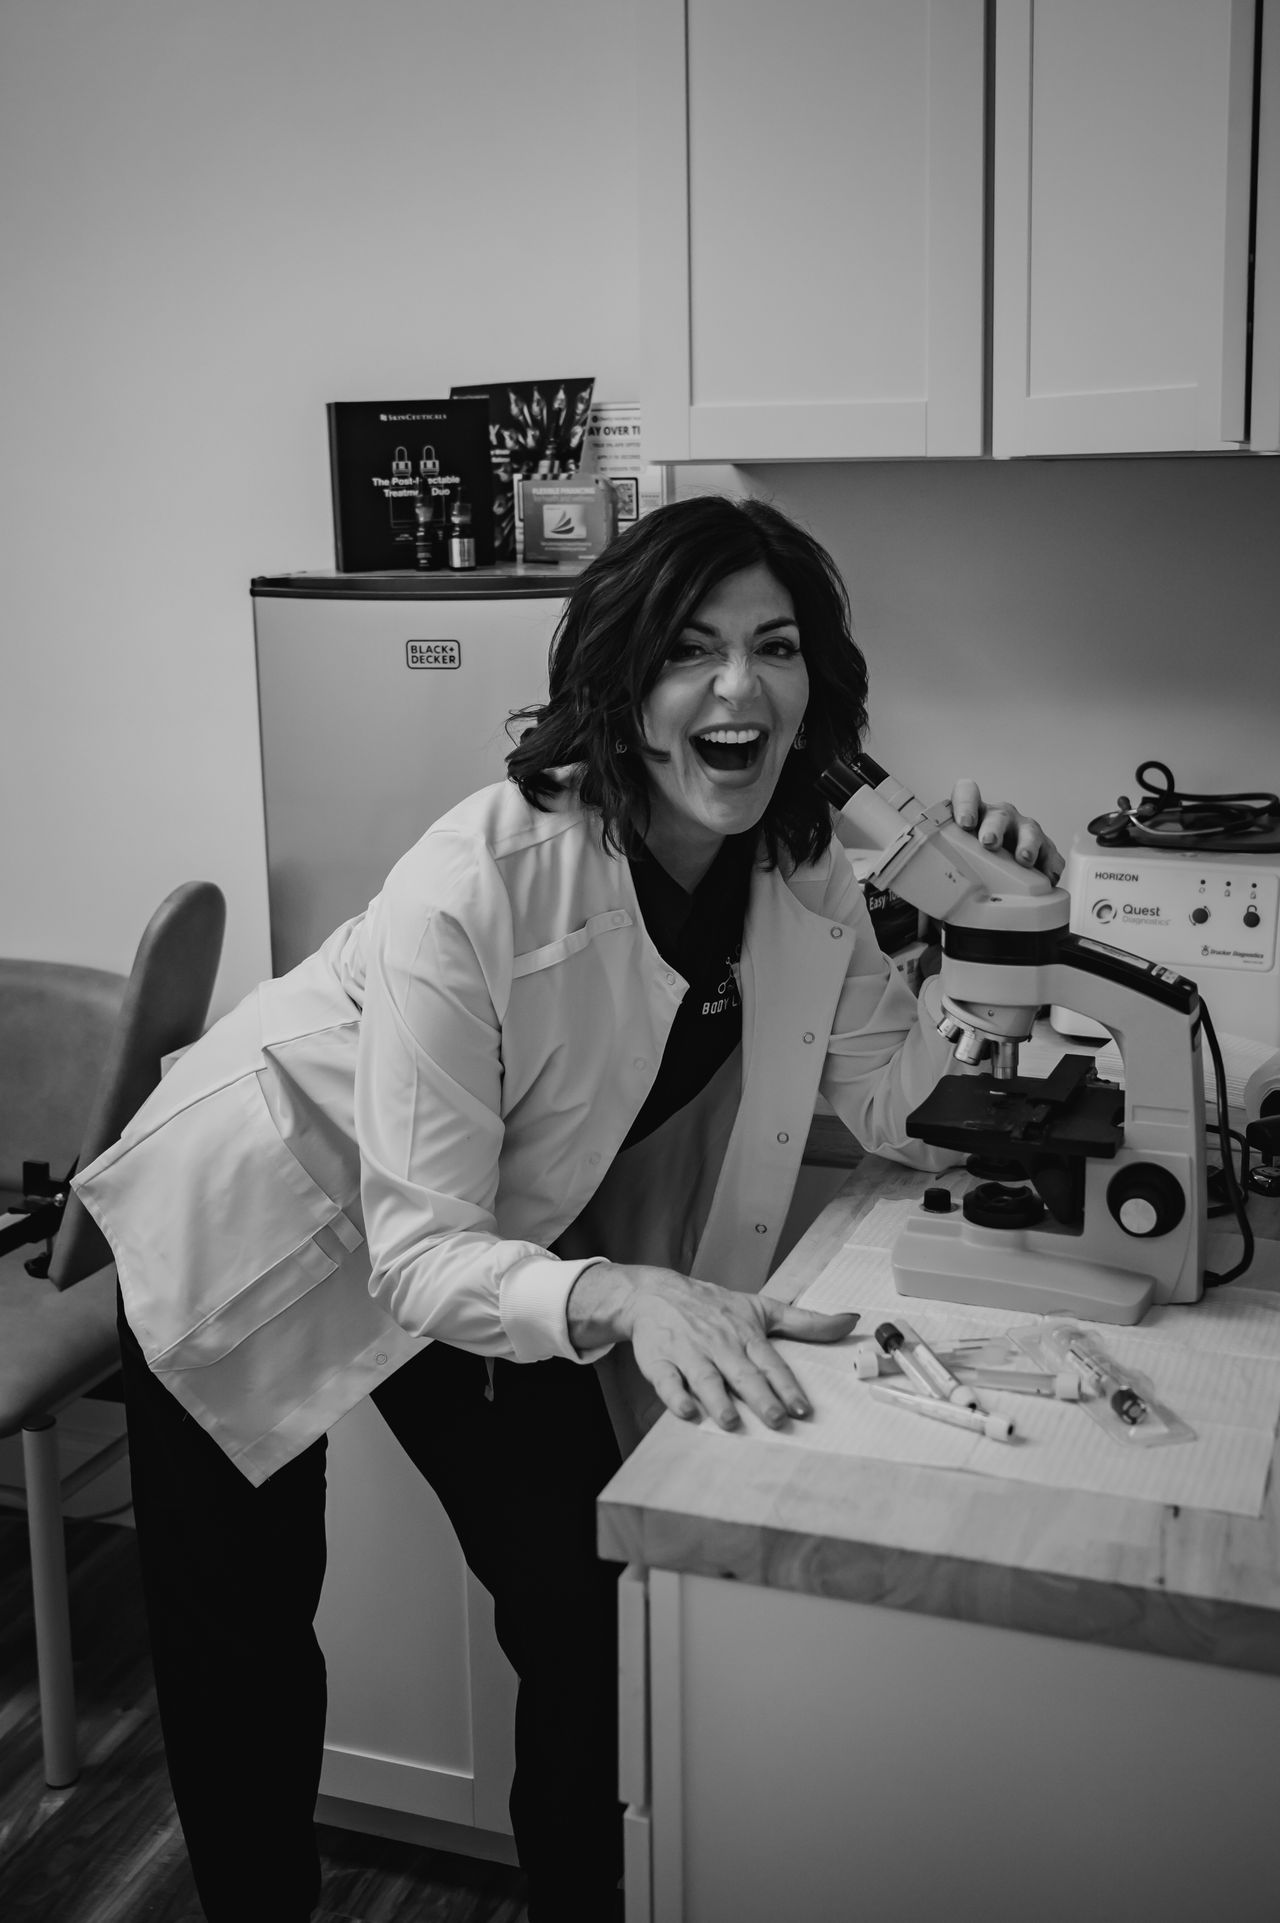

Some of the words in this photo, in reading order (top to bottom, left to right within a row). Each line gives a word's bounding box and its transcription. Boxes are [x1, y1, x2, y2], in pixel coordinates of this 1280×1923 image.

[588, 426, 601, 437] AY
[603, 426, 629, 436] OVER
[631, 425, 640, 435] TI
[372, 477, 390, 487] The
[431, 487, 450, 496] Duo
[410, 645, 455, 654] BLACK+
[411, 655, 456, 664] DECKER
[1095, 872, 1139, 882] HORIZON
[870, 895, 887, 911] Easy
[1122, 904, 1161, 917] Quest
[702, 998, 729, 1015] BODY
